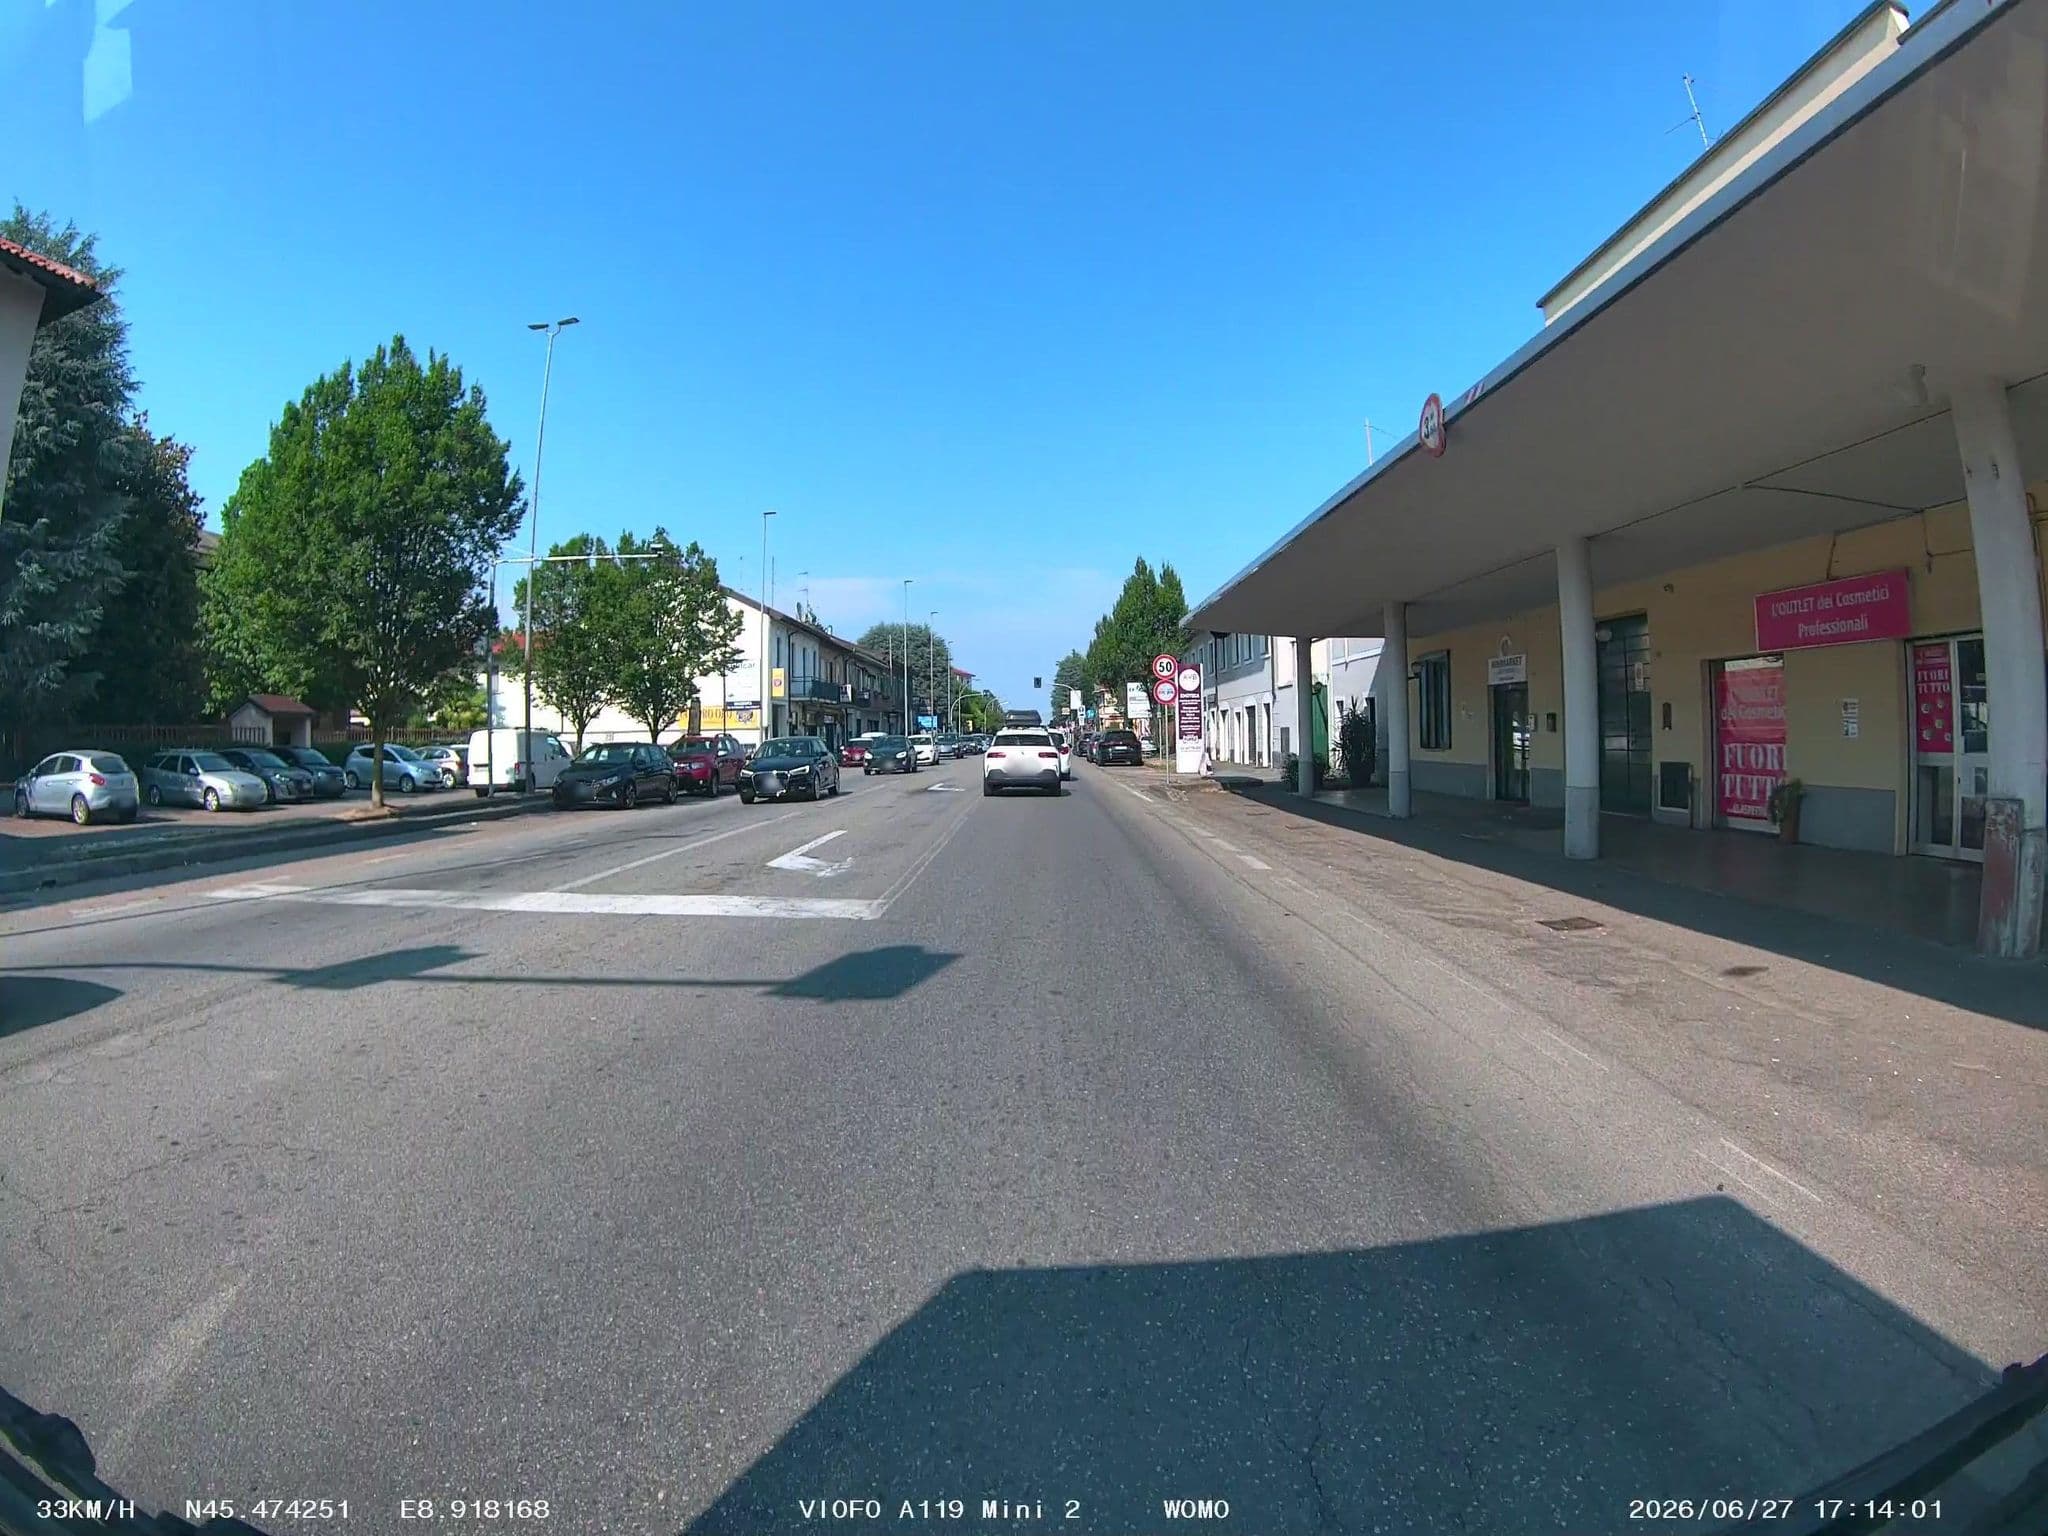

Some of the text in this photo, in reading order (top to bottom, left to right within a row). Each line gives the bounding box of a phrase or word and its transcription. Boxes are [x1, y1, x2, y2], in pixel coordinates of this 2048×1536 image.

[1771, 584, 1889, 617] L'OUTLET dei Cosmetici
[1797, 613, 1868, 638] Professionali
[1159, 661, 1172, 673] 50
[1916, 682, 1950, 694] TUTTO
